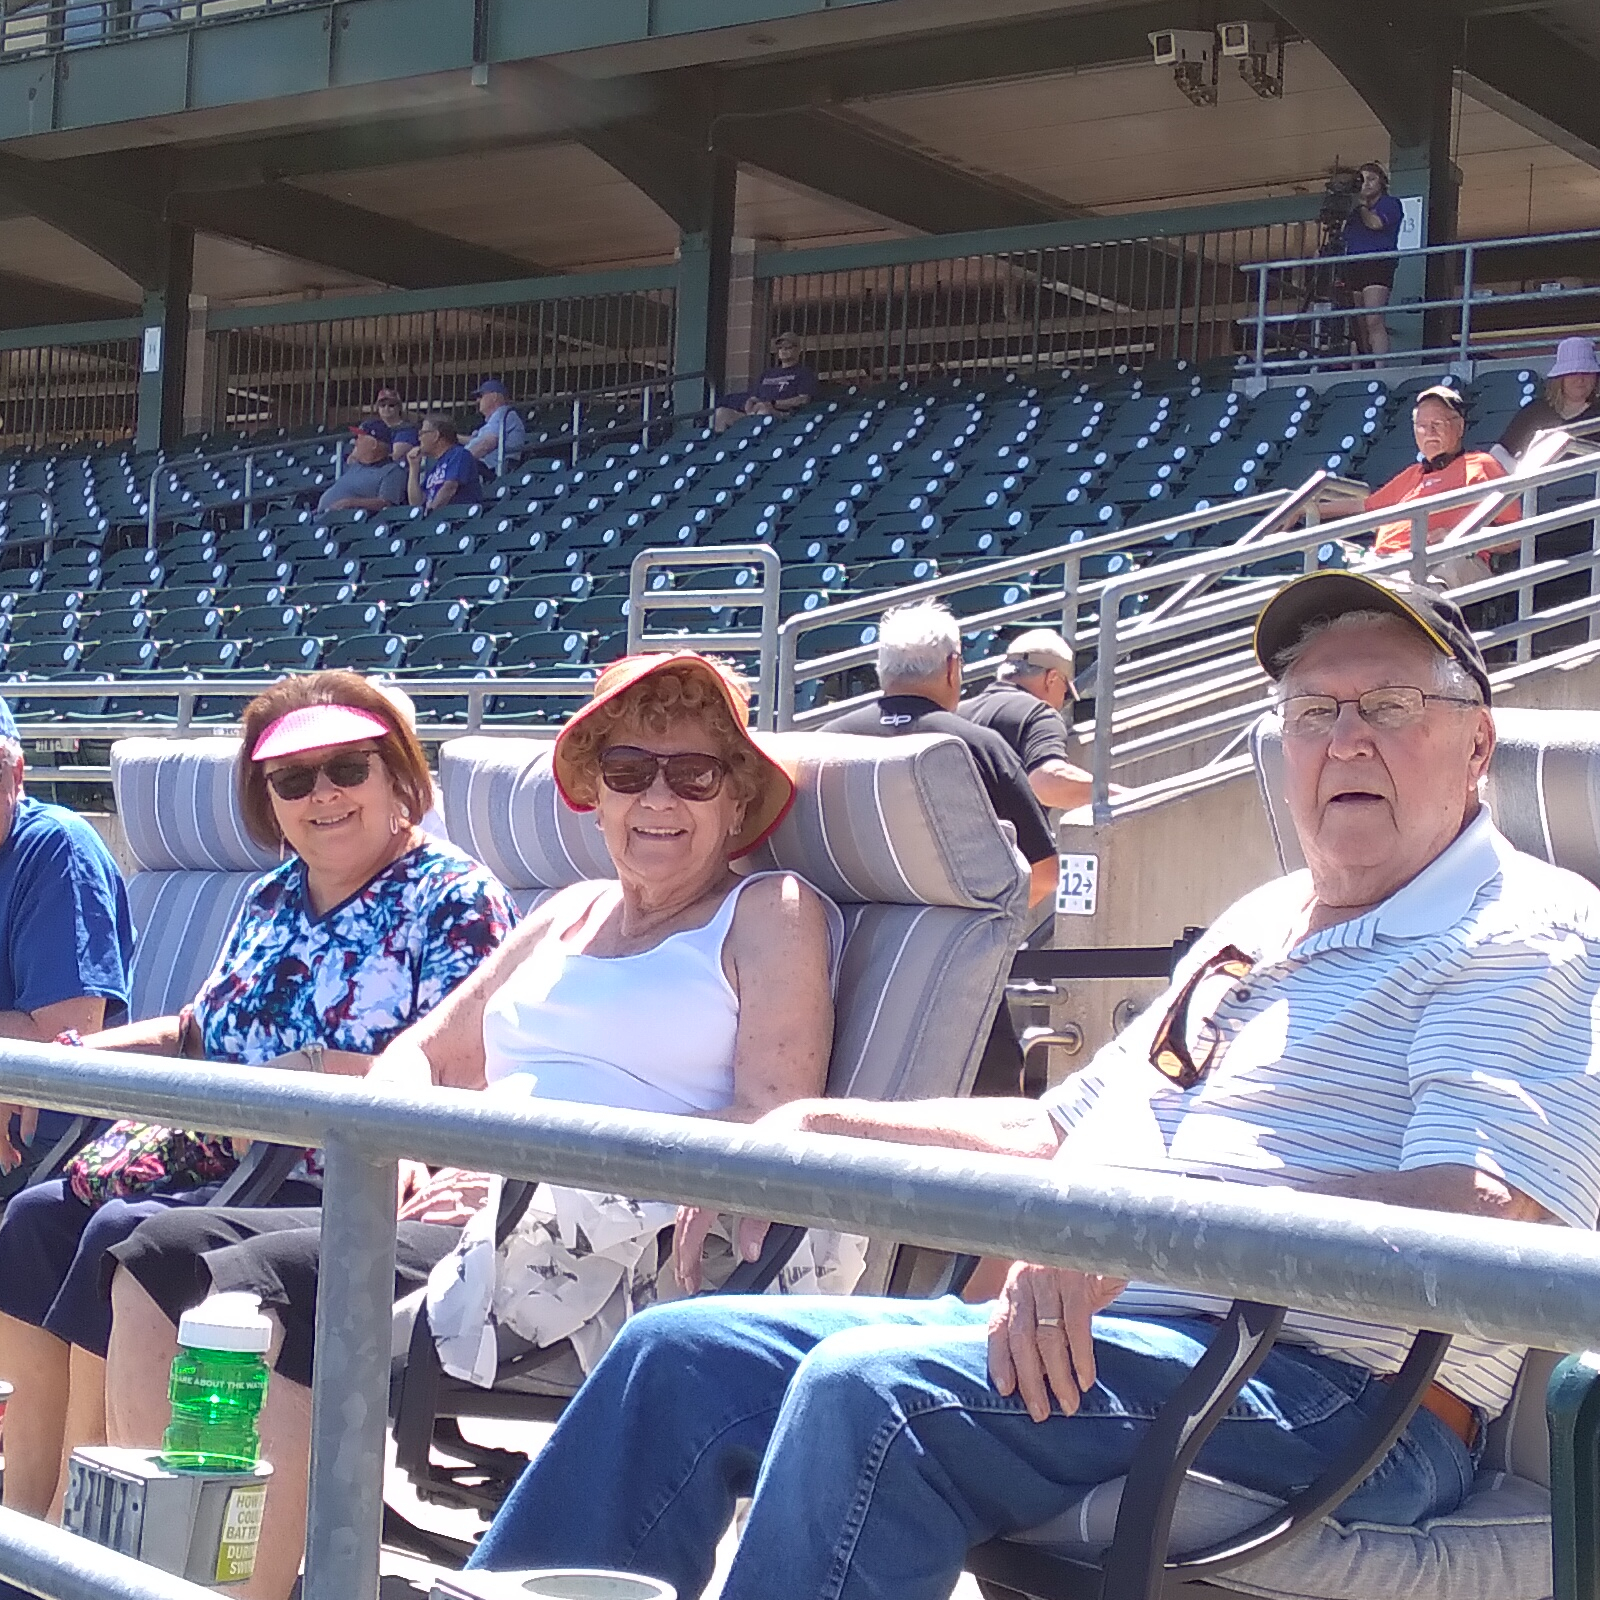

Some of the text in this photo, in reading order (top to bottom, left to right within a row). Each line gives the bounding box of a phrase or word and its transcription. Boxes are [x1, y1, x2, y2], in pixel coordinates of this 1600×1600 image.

[1061, 872, 1083, 896] 12
[193, 1377, 226, 1389] ABOUT
[226, 1381, 245, 1390] THE
